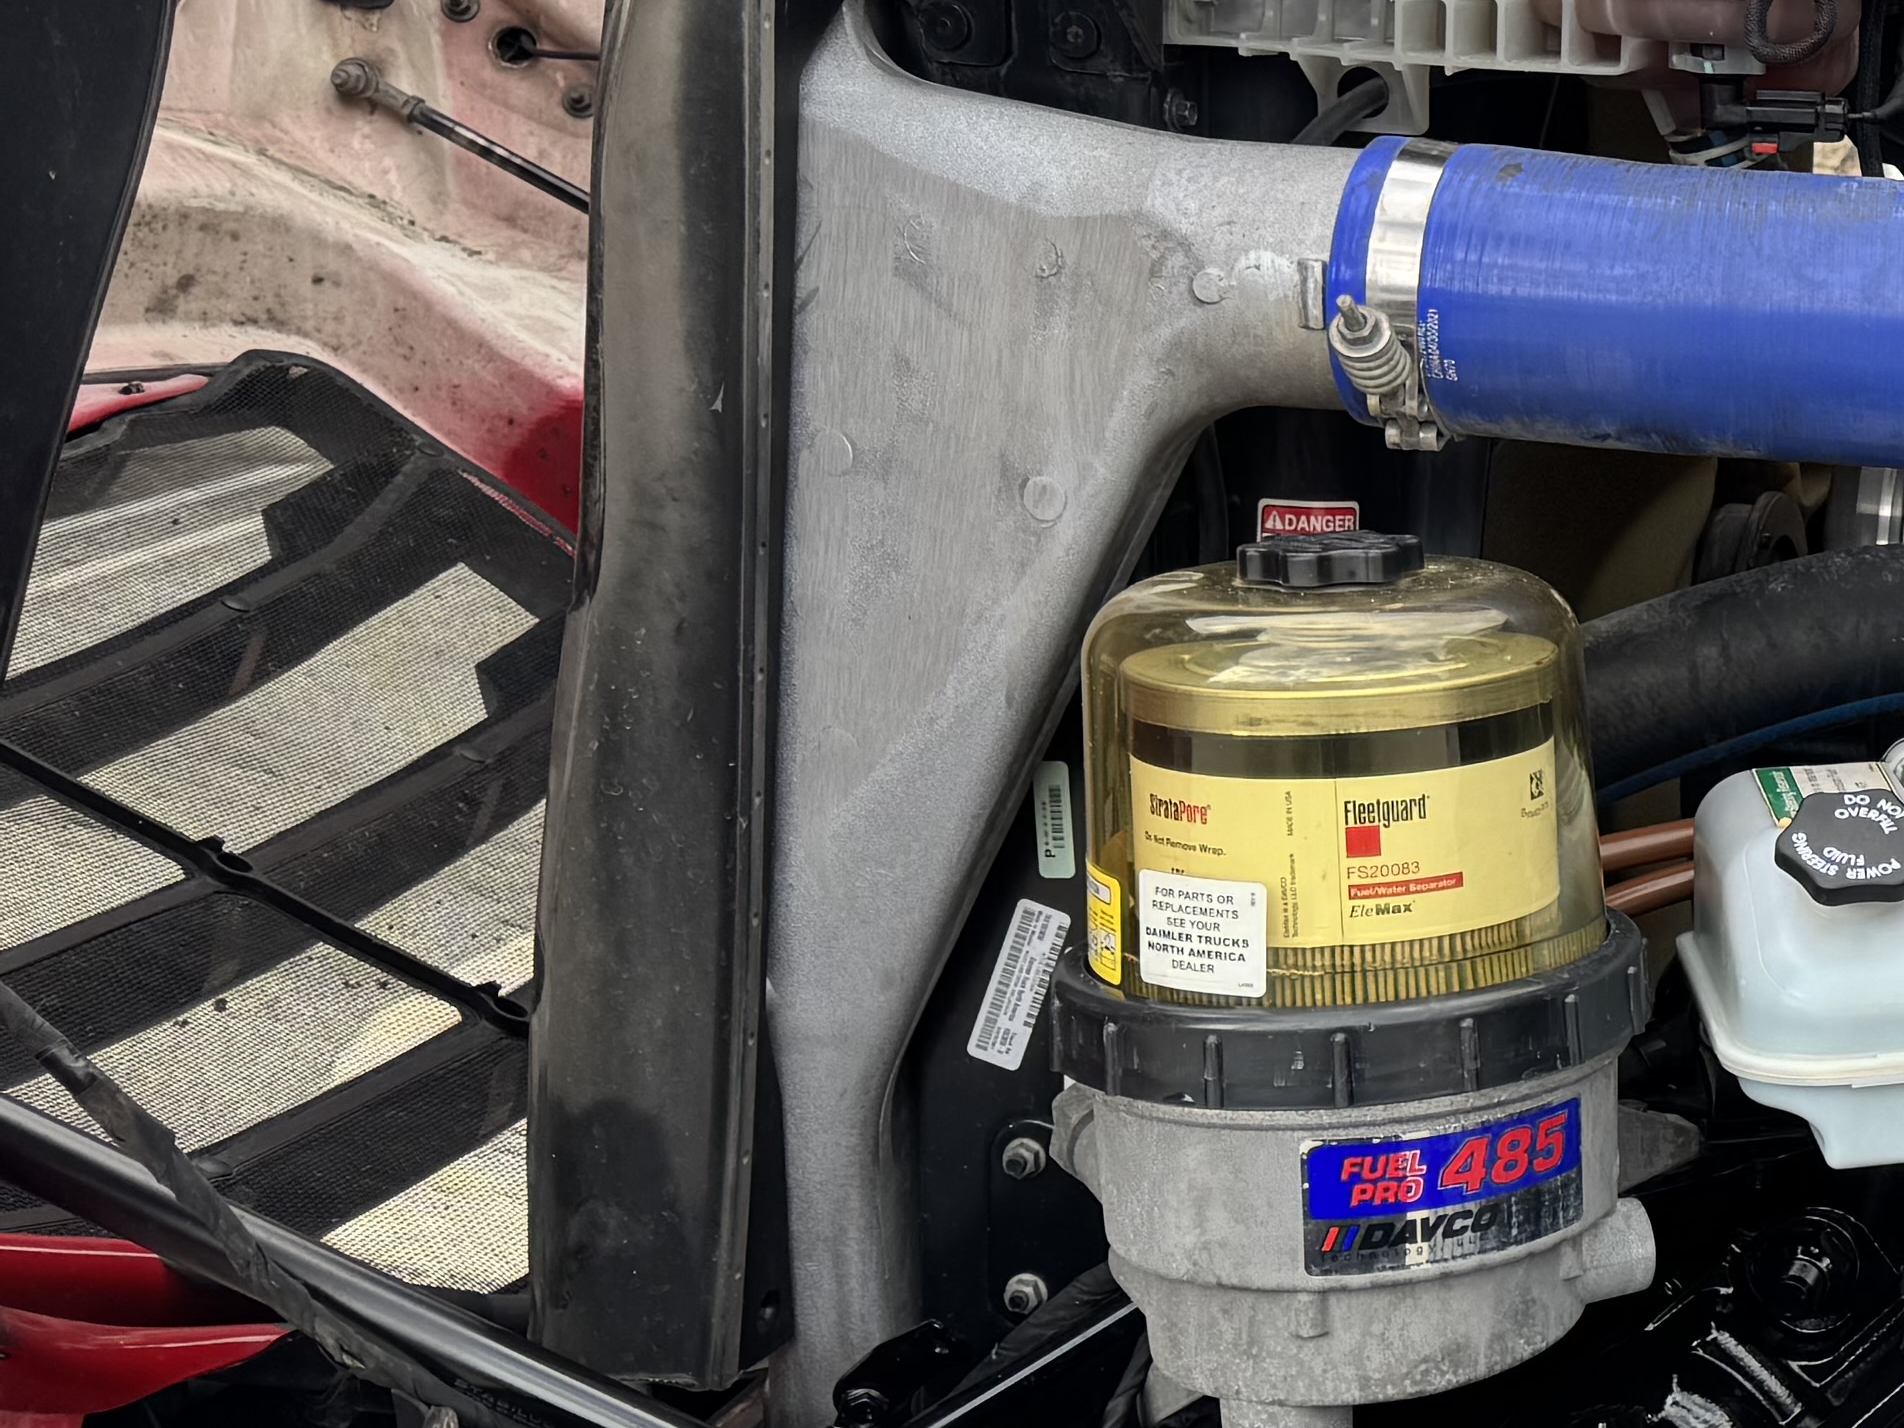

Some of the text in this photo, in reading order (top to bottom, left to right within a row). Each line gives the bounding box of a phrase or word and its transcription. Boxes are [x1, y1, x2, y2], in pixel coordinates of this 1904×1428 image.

[1284, 513, 1355, 533] DANGER
[1284, 791, 1292, 806] USA
[1844, 794, 1870, 805] DO
[1343, 793, 1427, 828] Fleetguard
[1834, 807, 1898, 834] OVERFILL
[1154, 834, 1165, 846] Not
[1166, 837, 1197, 853] Remove
[1199, 844, 1227, 857] Wrap.
[1791, 832, 1902, 880] POWER STEERING
[1823, 846, 1865, 866] FLUID
[1346, 860, 1421, 880] FS20083
[1155, 886, 1234, 905] FOR PARTS OR
[1350, 877, 1456, 898] Fuel/Water Separator
[1152, 900, 1239, 920] REPLACEMENTS
[1349, 901, 1413, 919] EleMax
[1166, 917, 1221, 932] SEE YOUR
[1145, 926, 1250, 948] DAIMLER TRUCKS
[1147, 942, 1246, 963] NORTH AMERICA
[1171, 960, 1215, 973] DEALER
[1437, 1108, 1569, 1195] 485
[1340, 1149, 1427, 1182] FUEL
[1350, 1176, 1425, 1208] PRO
[1357, 1202, 1501, 1251] DAVCO
